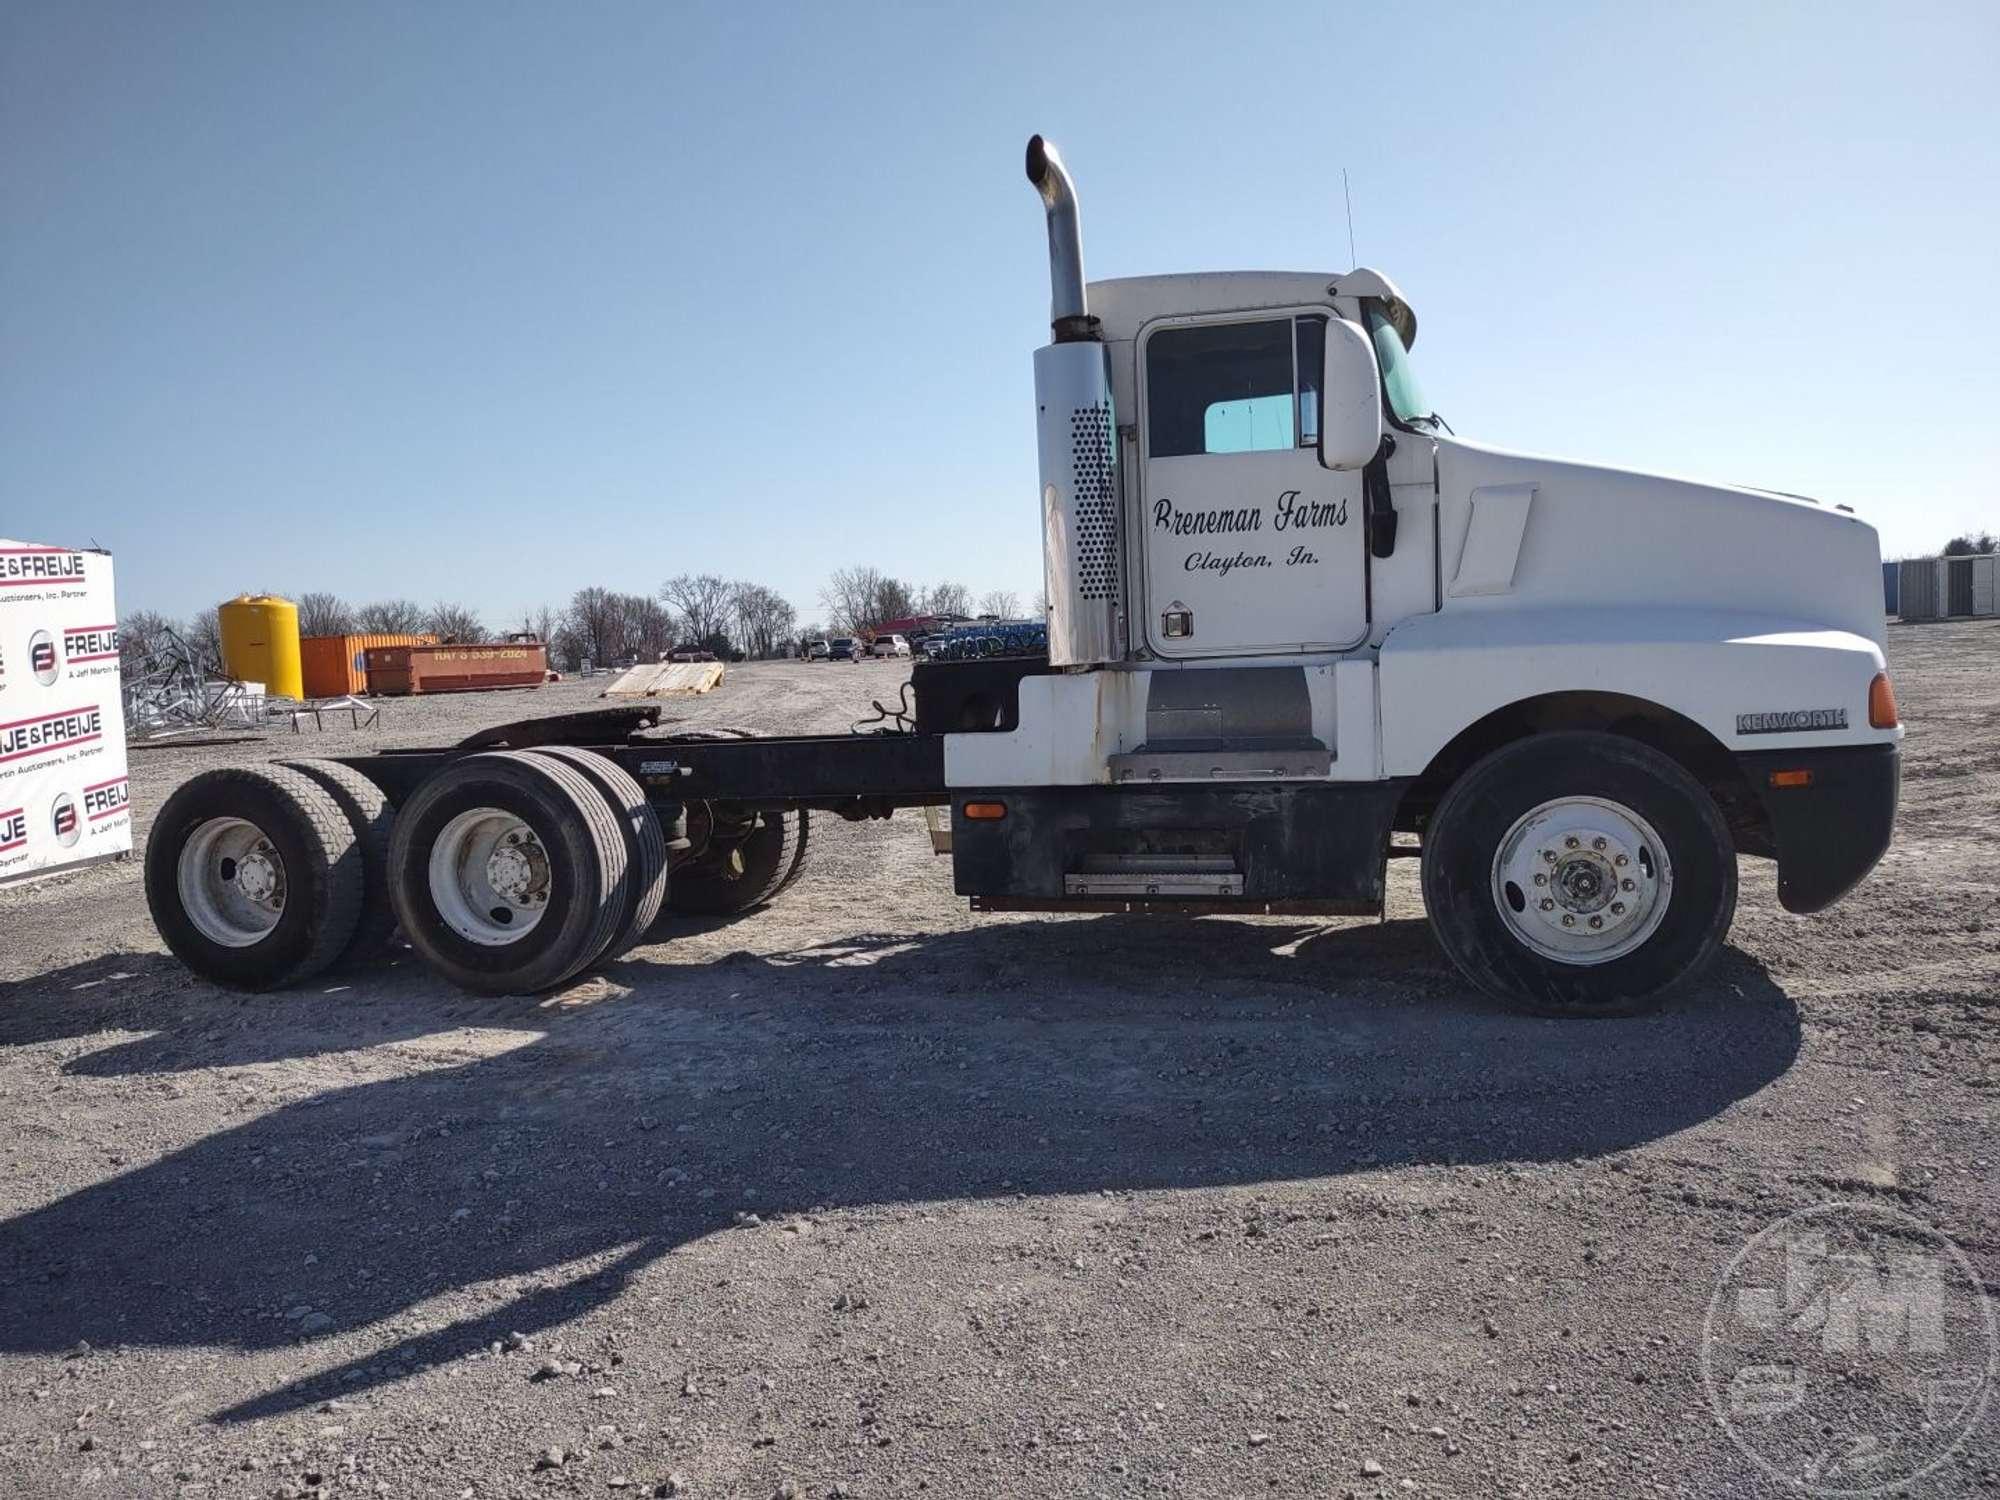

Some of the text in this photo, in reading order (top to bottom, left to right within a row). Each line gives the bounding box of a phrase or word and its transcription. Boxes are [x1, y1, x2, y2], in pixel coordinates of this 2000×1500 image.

[1274, 490, 1349, 532] Farms
[1184, 545, 1320, 577] Clayton, In.
[1736, 708, 1849, 736] KENWORTH
